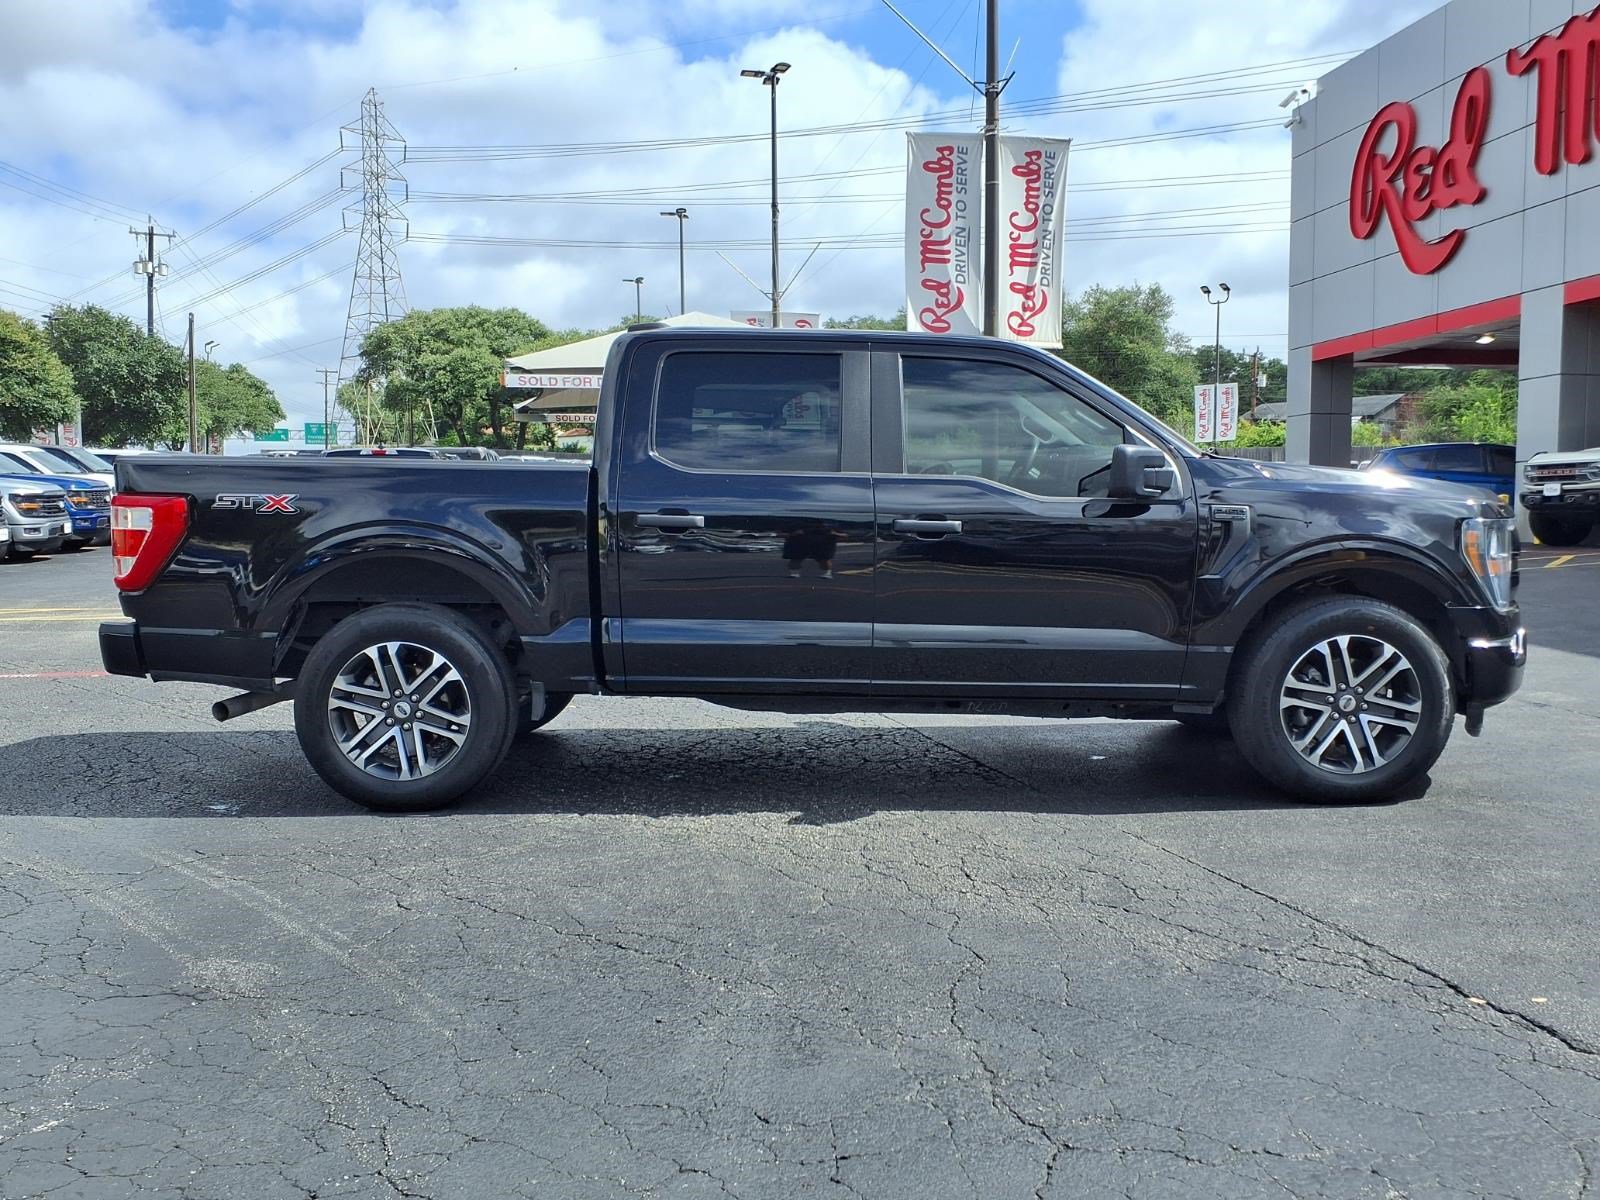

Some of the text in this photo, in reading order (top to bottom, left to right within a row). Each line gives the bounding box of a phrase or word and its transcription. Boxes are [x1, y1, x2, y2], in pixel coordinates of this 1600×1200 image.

[919, 145, 965, 333] Red McCombs
[955, 145, 969, 285] DRIVEN TO SERVE
[1040, 150, 1056, 288] DRIVEN TO SERVE
[1350, 67, 1492, 275] Red
[1007, 150, 1047, 337] Red McCombs
[518, 375, 558, 387] SOLD
[562, 376, 592, 387] FOR
[555, 414, 581, 422] SOLD
[211, 493, 300, 515] STX
